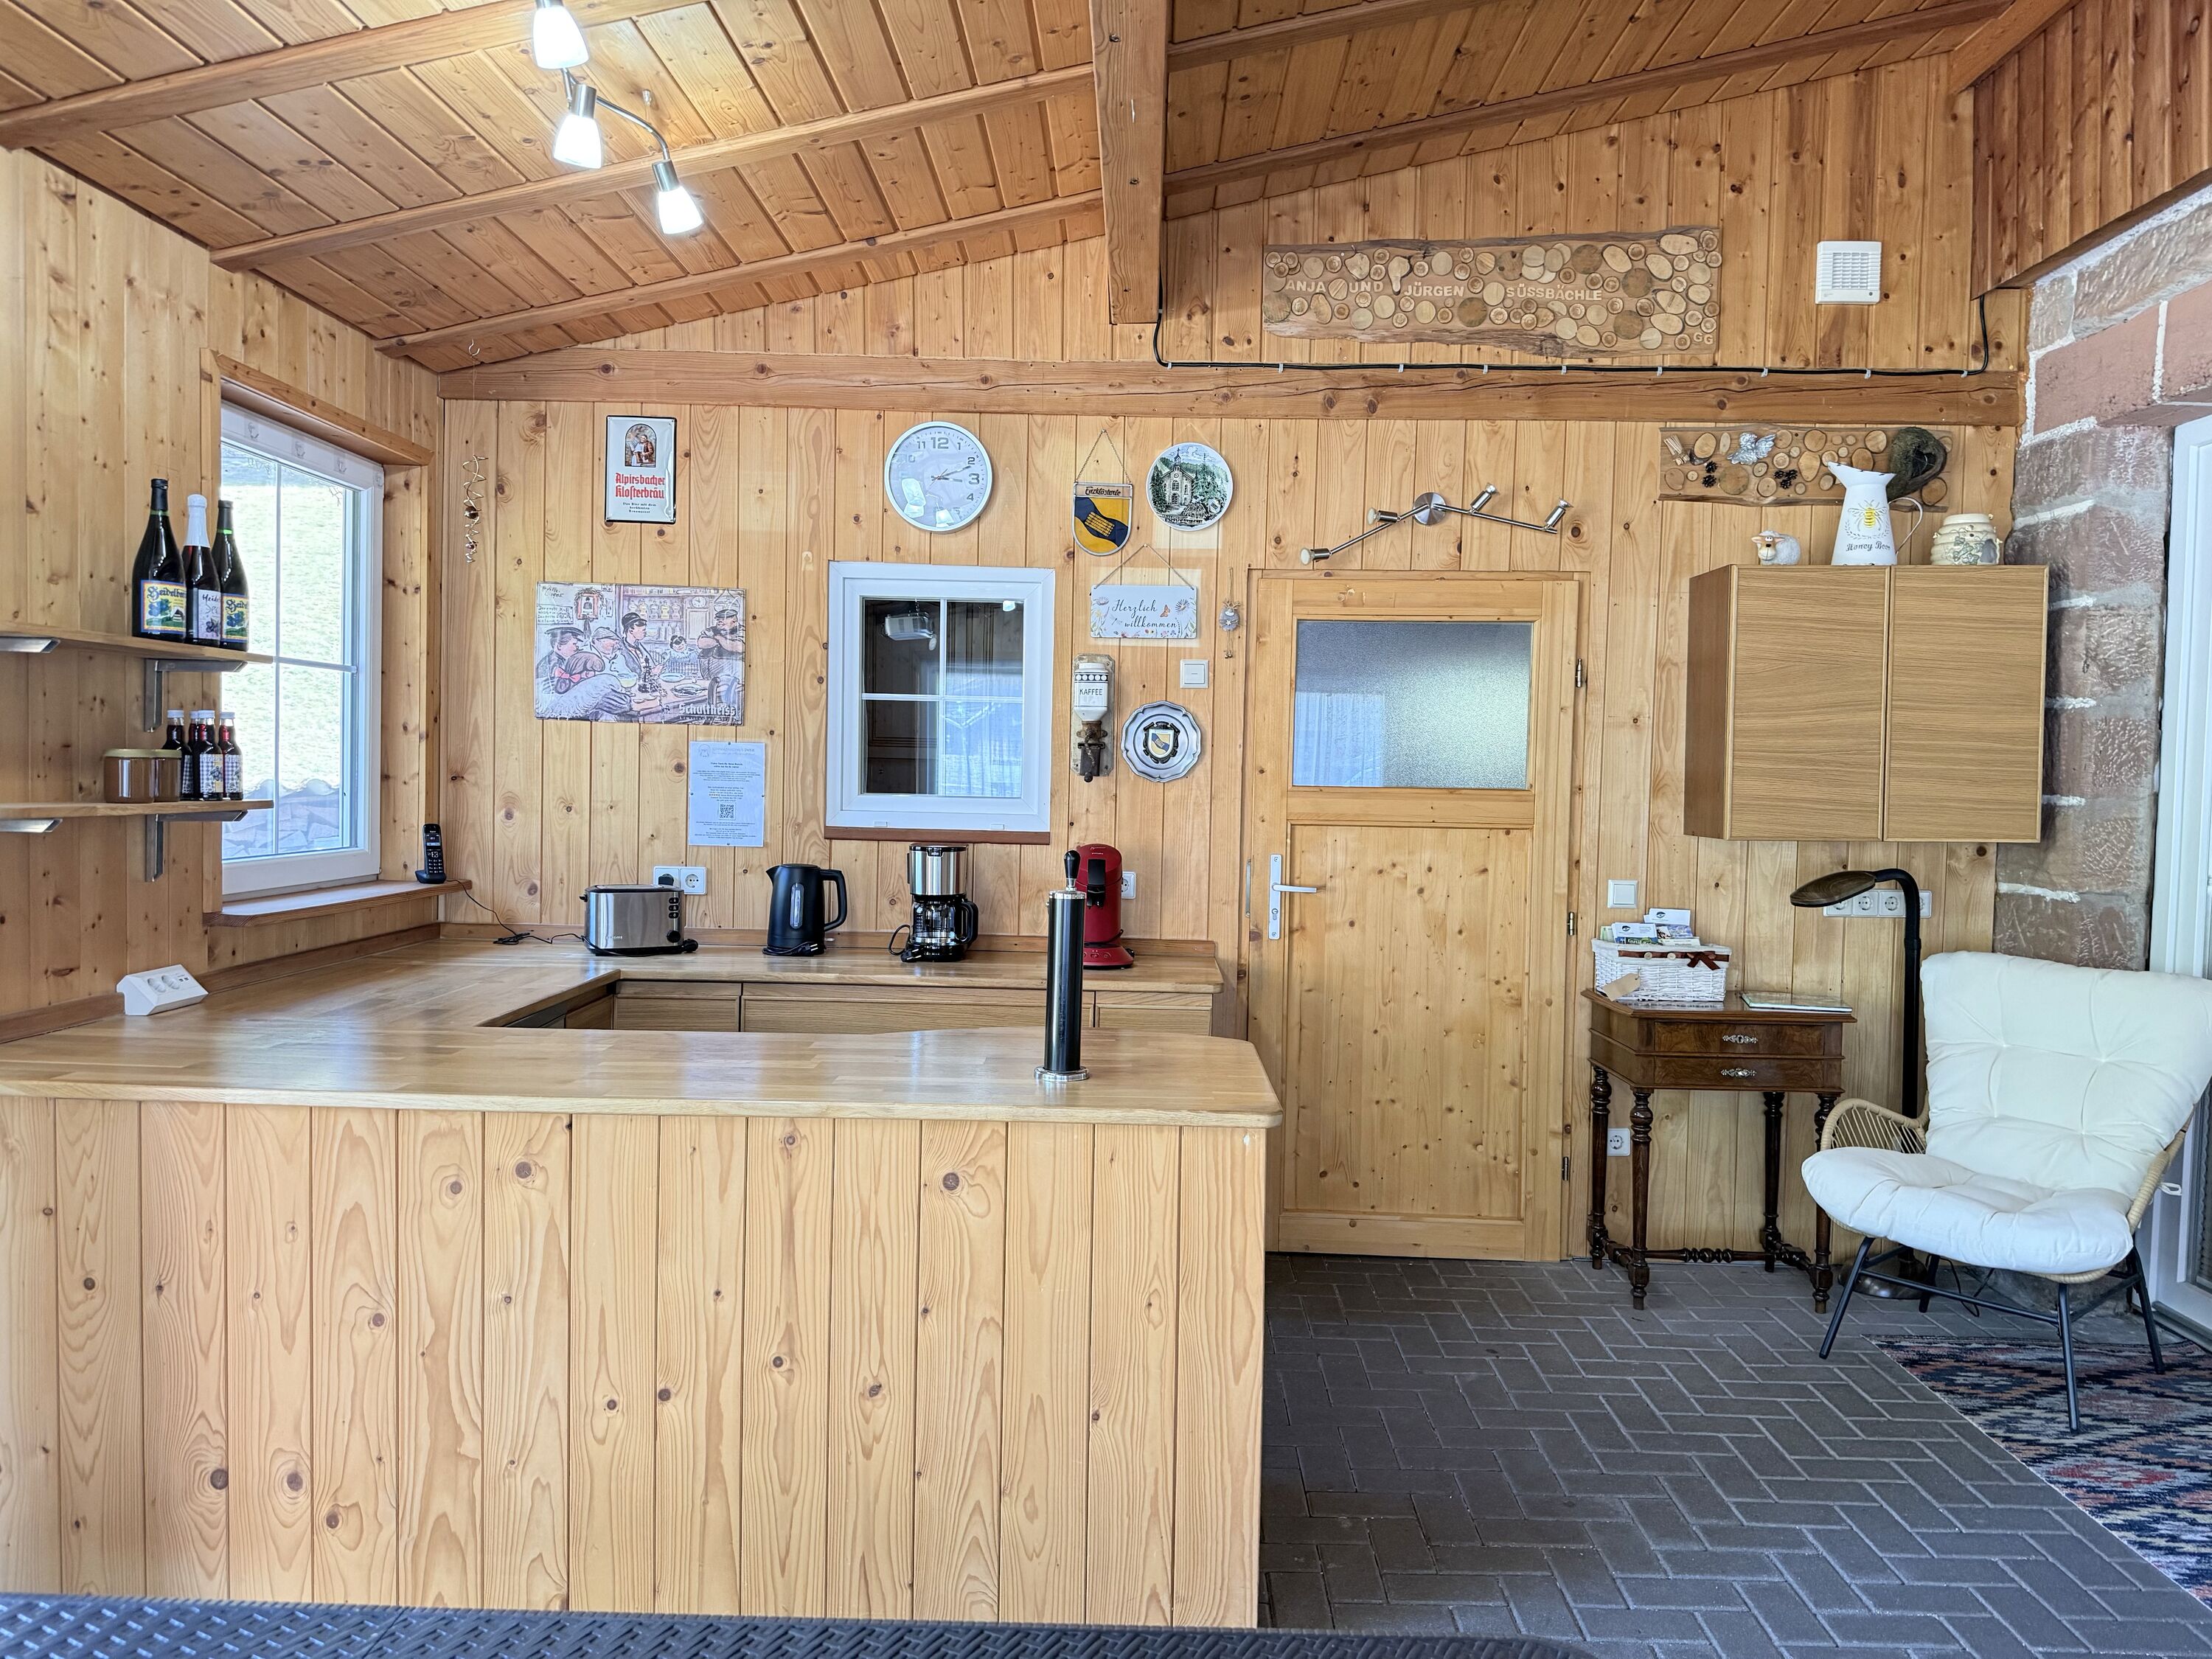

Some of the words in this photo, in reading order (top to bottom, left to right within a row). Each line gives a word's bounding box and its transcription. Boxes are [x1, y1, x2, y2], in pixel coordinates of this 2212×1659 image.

[1285, 279, 1326, 293] ANJA
[1349, 281, 1383, 293] UND
[1404, 282, 1464, 296] JÜRGEN
[1506, 283, 1602, 301] SÜSSBÄCHLE
[917, 441, 926, 449] 11
[931, 437, 949, 449] 12
[957, 442, 961, 451] 1
[967, 456, 975, 465] 2
[616, 473, 666, 486] Alpirsbacher
[968, 473, 980, 485] 3
[966, 493, 974, 501] 4
[1846, 543, 1873, 552] Honey
[1111, 599, 1158, 619] Herzlich
[1124, 615, 1177, 627] willkommen
[1079, 688, 1103, 696] KAFFEE
